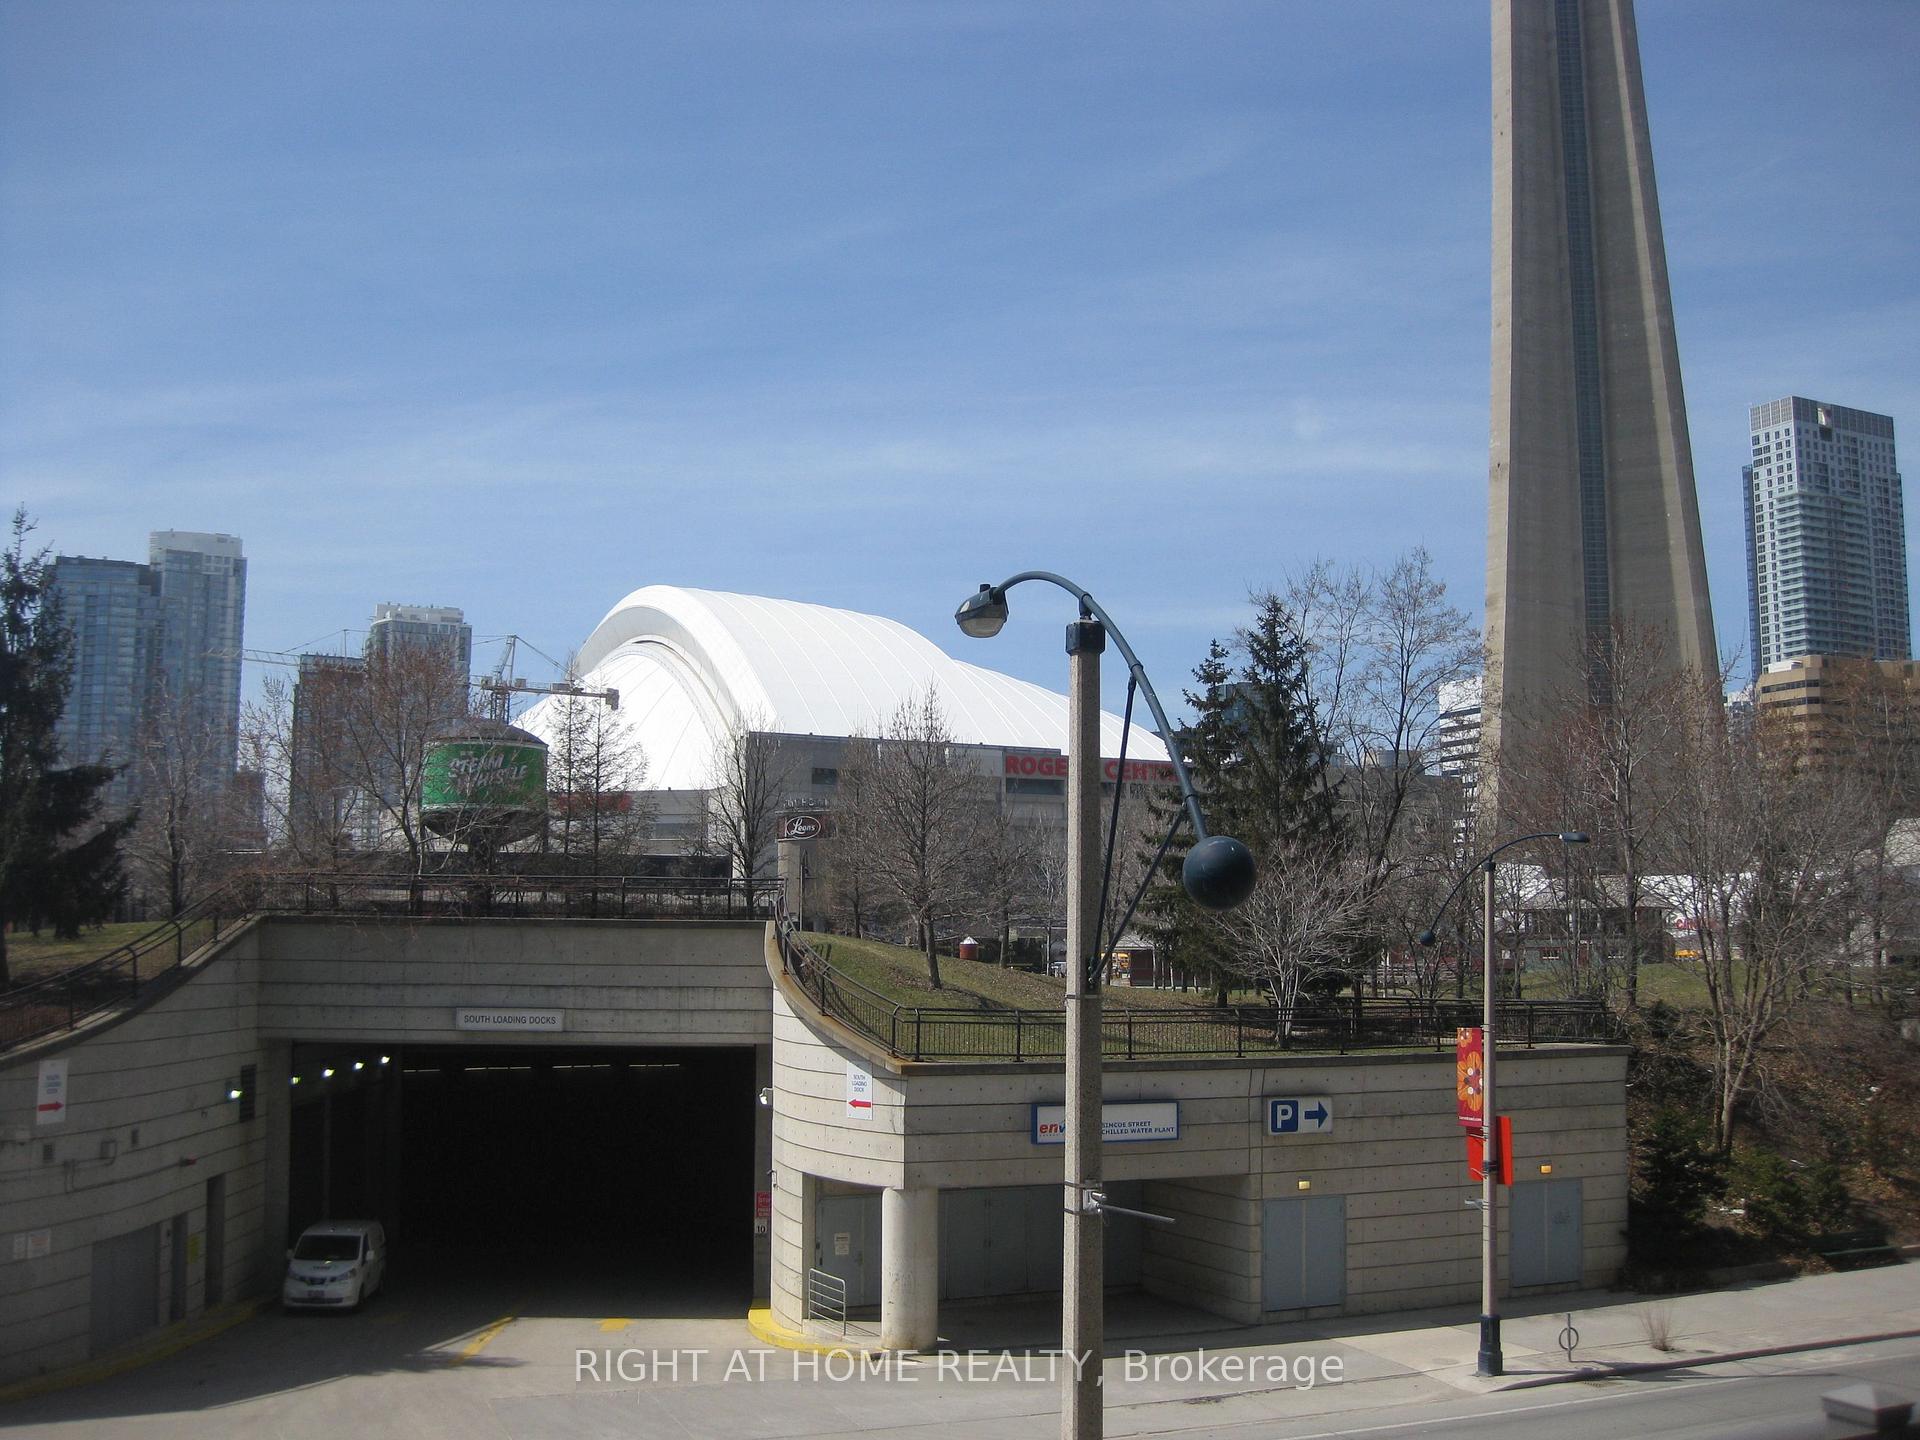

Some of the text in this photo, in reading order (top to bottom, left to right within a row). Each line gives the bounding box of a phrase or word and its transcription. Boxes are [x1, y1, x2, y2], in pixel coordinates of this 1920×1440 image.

[1006, 756, 1068, 776] ROGE
[464, 1015, 556, 1025] SOUTH LOADING DOCKS
[1277, 1105, 1293, 1128] P
[1102, 1127, 1128, 1135] CHILLED
